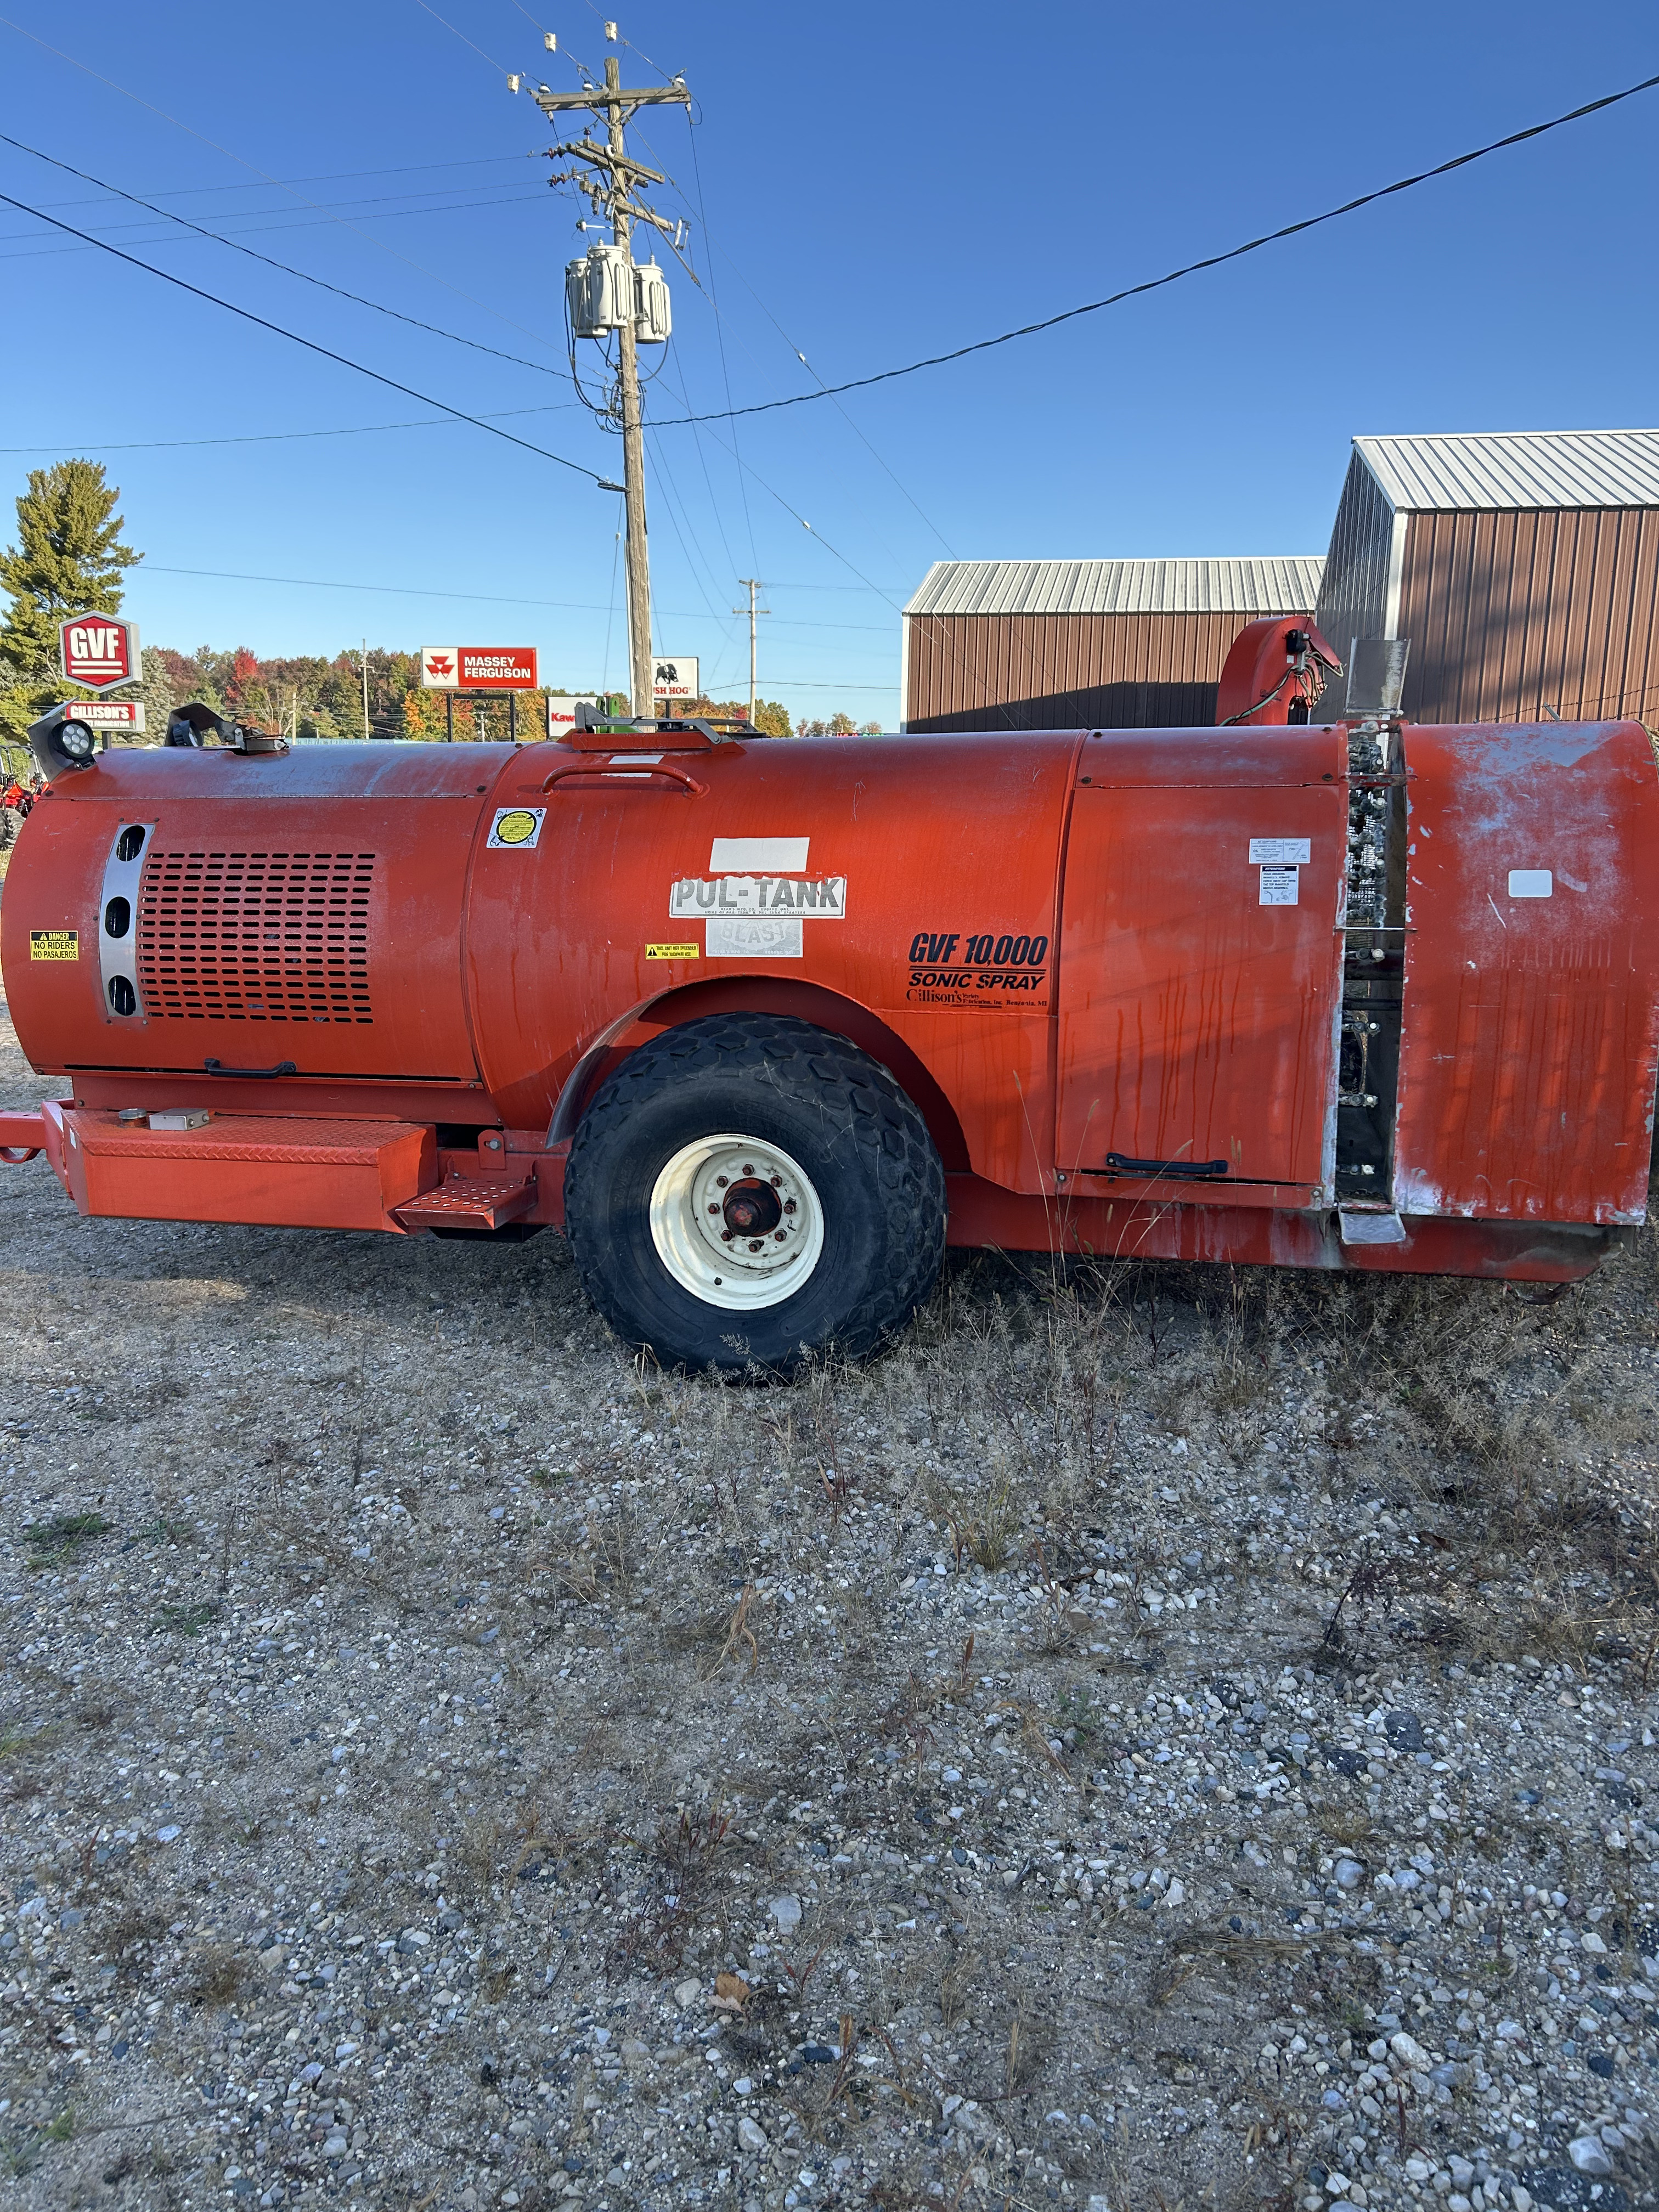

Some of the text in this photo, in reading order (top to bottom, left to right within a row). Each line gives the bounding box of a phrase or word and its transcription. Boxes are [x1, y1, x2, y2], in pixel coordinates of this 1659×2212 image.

[70, 627, 119, 659] GVF
[464, 656, 516, 667] MASSEY
[465, 668, 531, 679] FERGUSON
[669, 686, 689, 695] HOG
[70, 705, 129, 719] GILLISON'S
[551, 713, 575, 722] Kaw
[675, 878, 840, 908] PUL-TANK
[34, 941, 75, 950] NO RIDERS
[909, 933, 1048, 967] GVF 10,000
[33, 950, 77, 958] NO PASAJEROS
[909, 972, 1046, 990] SONIC SPRAY
